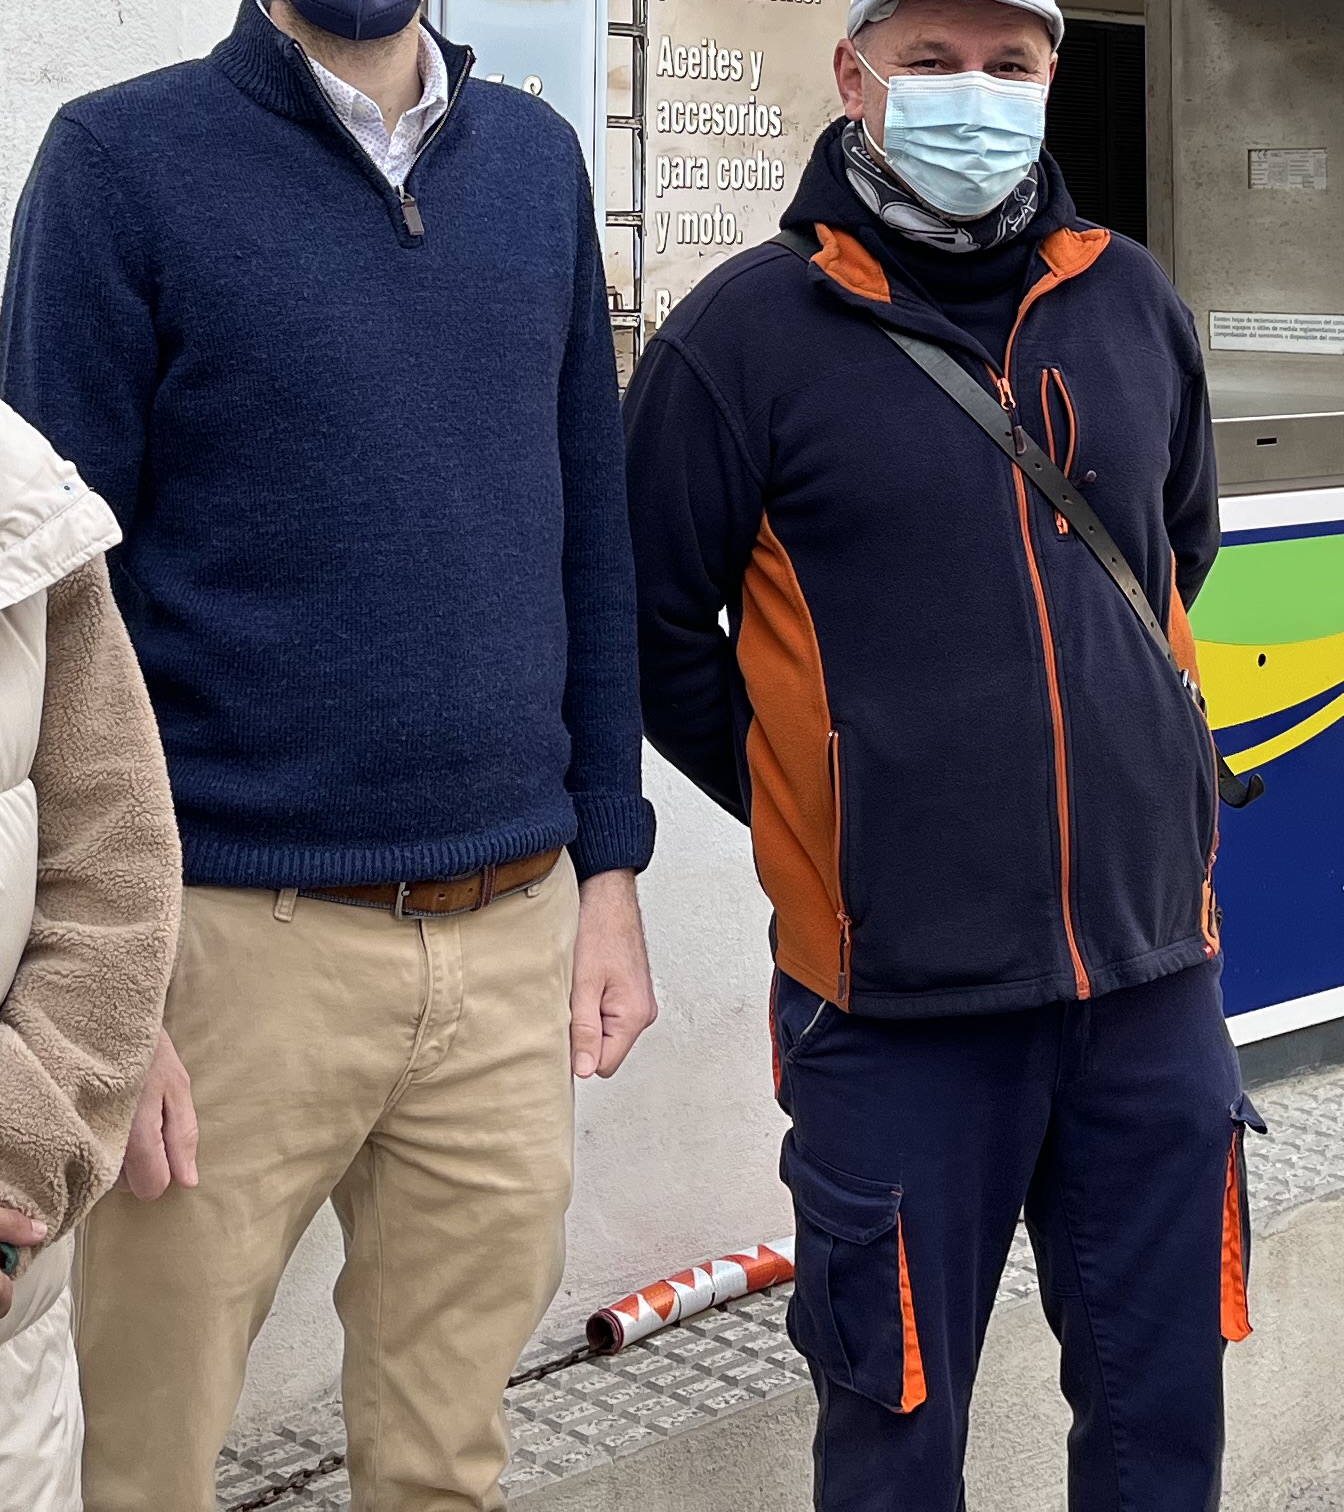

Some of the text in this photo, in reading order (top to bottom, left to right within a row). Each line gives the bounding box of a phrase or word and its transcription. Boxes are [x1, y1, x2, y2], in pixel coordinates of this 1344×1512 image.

[656, 35, 763, 91] Aceites y
[656, 94, 781, 137] accesorios
[655, 152, 784, 198] para coche
[656, 202, 743, 253] y moto.
